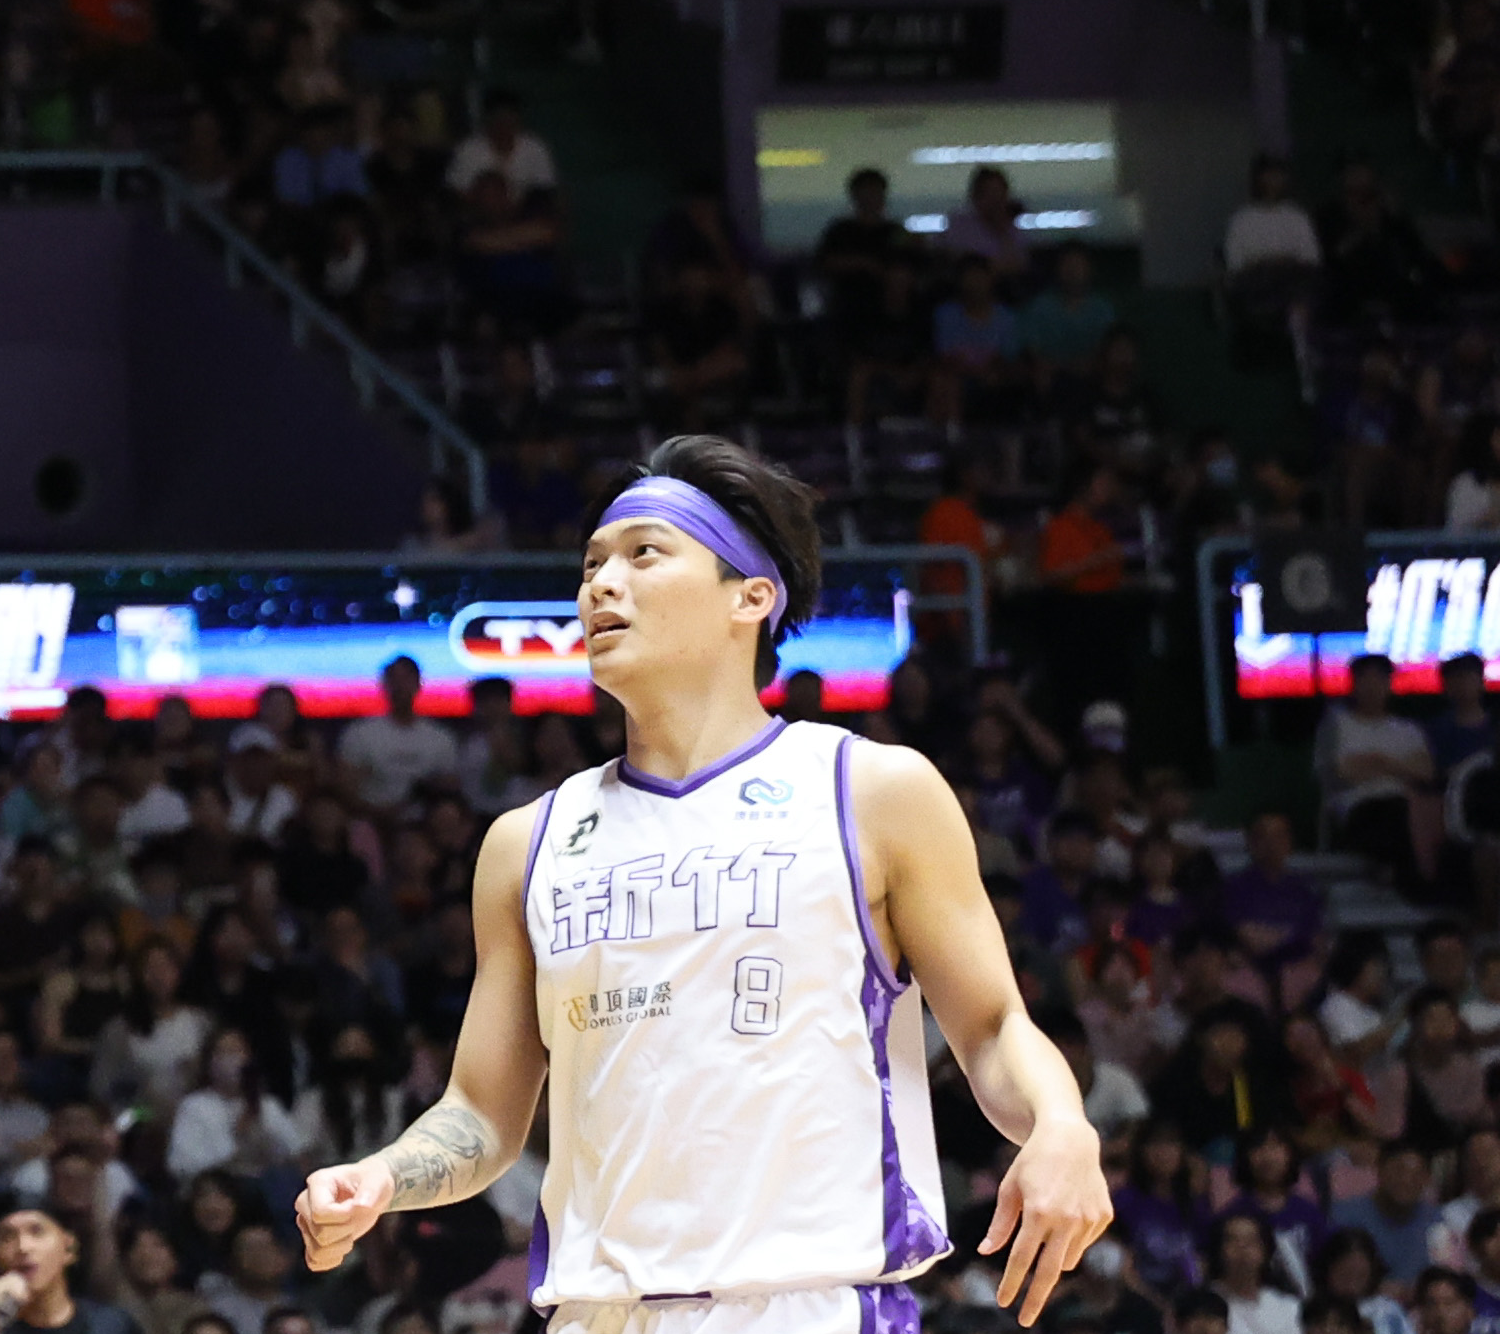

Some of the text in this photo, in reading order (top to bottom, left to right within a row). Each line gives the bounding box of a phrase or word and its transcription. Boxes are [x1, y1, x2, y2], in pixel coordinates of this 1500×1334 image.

[487, 618, 584, 657] TY
[550, 840, 797, 955] 新竹
[730, 955, 784, 1036] 8
